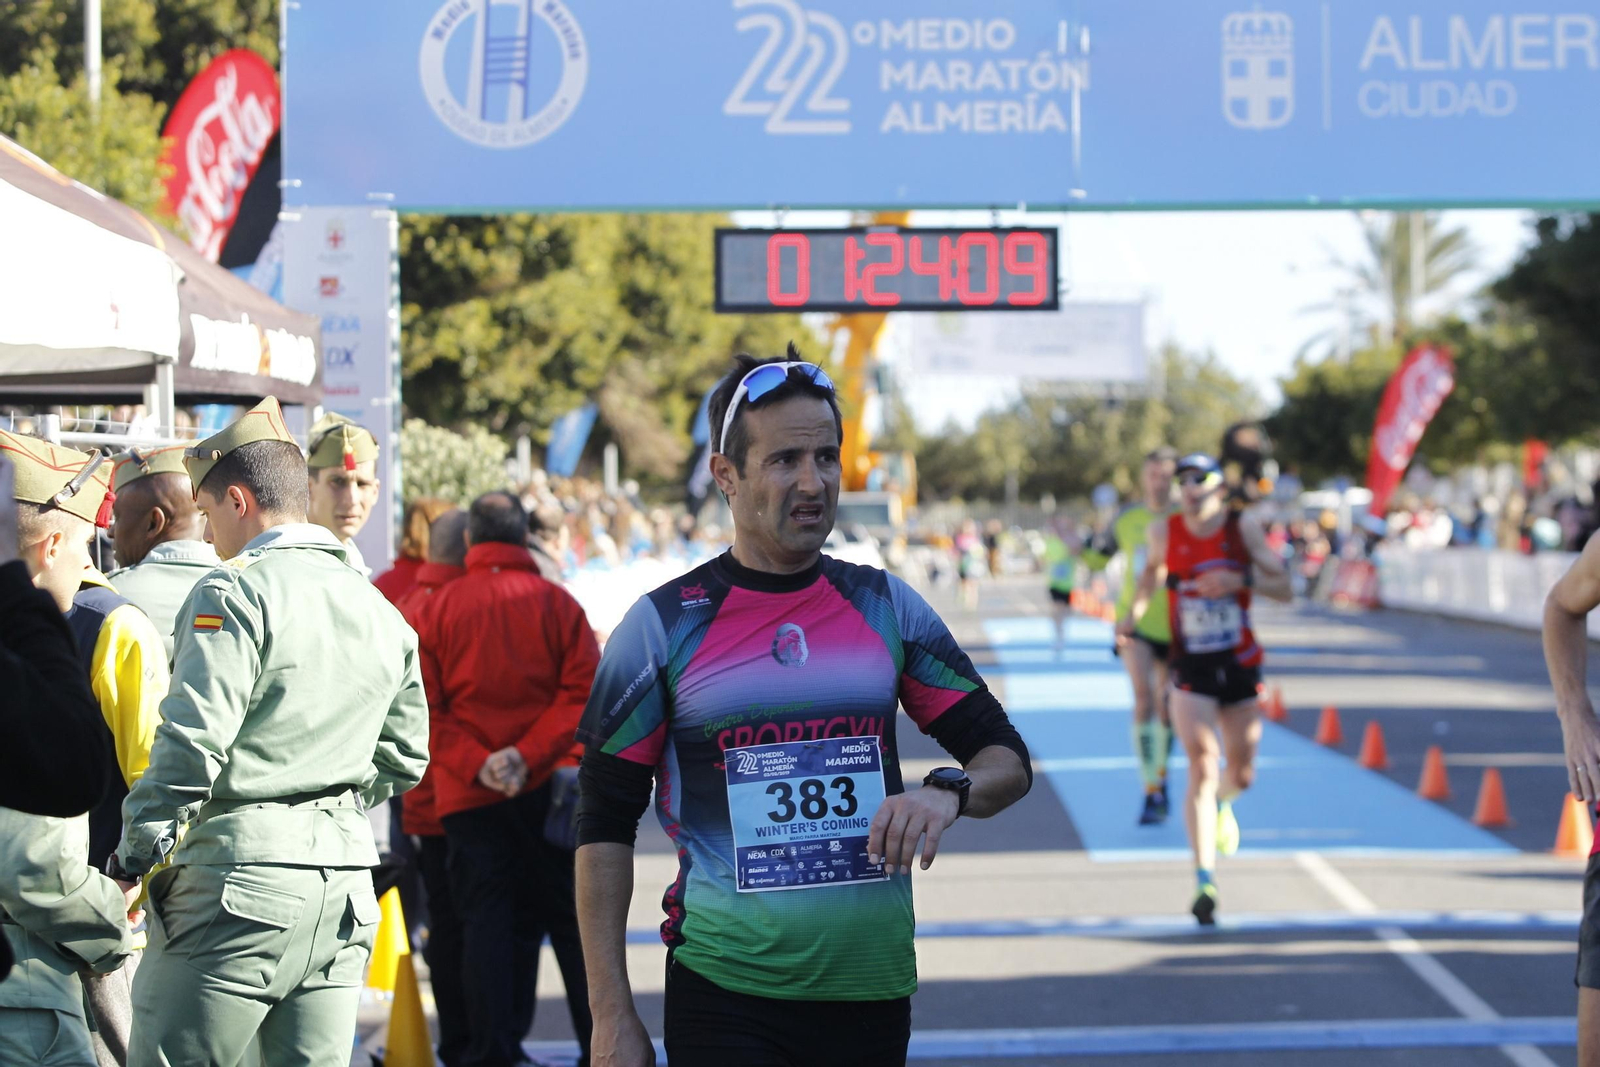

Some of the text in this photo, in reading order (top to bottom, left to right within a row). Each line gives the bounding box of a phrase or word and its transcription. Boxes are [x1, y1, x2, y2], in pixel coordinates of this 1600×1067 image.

[880, 18, 1016, 52] MEDIO
[1359, 14, 1600, 71] ALMER
[880, 52, 1089, 92] MARATÓN
[1357, 80, 1518, 118] CIUDAD
[880, 93, 1067, 133] ALMERÍA
[704, 712, 744, 738] Centro
[761, 751, 785, 759] MEDIO
[841, 744, 871, 754] MEDIO
[762, 756, 798, 766] MARATÓN
[763, 763, 795, 772] ALMERÍA
[825, 754, 872, 767] MARATÓN
[765, 776, 858, 823] 383
[821, 817, 869, 831] COMING
[747, 851, 767, 860] NEXA
